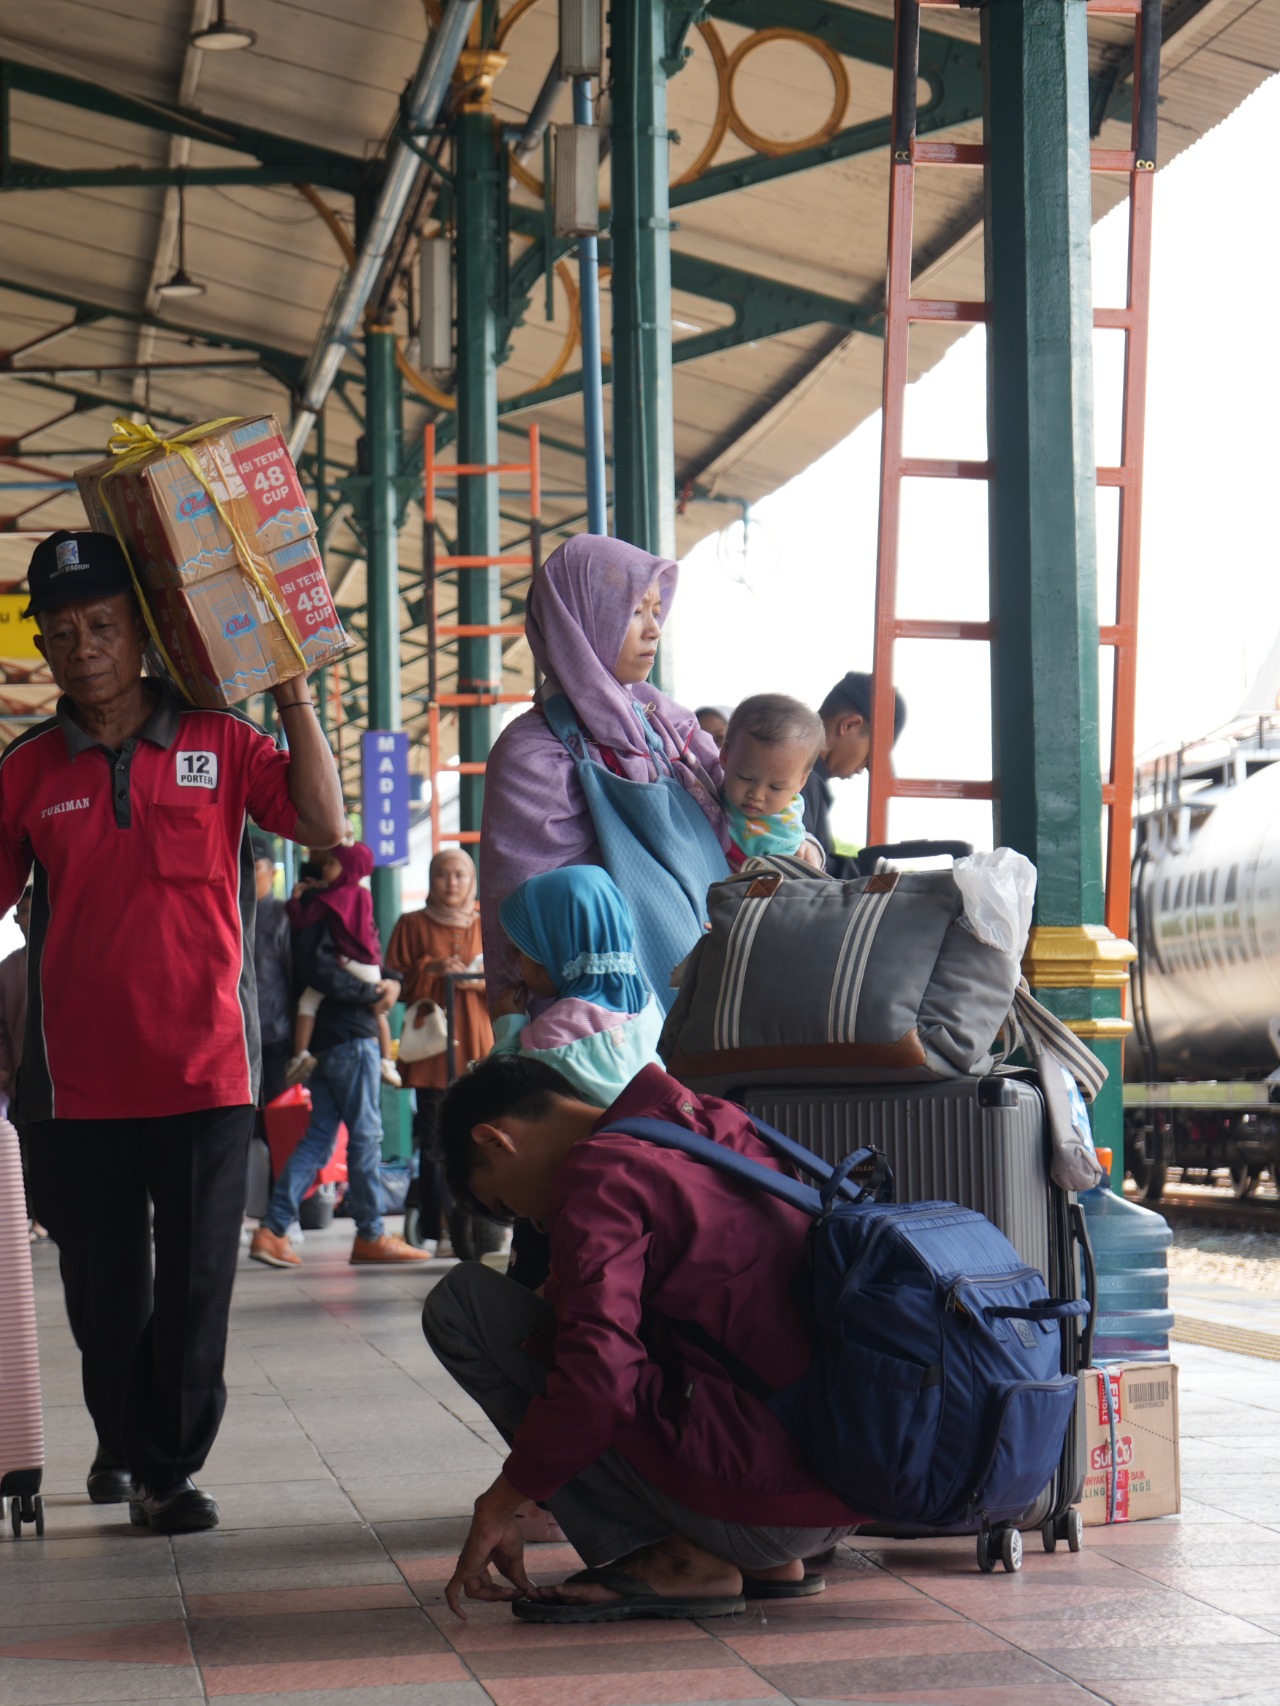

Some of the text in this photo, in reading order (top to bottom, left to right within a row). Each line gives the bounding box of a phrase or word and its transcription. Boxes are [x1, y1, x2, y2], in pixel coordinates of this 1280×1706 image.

[239, 447, 285, 475] ISI TETAP
[254, 465, 285, 491] 48
[262, 485, 290, 505] CUP
[280, 571, 324, 596] ISI TETA
[296, 586, 328, 612] 48
[225, 613, 251, 636] Club
[305, 606, 333, 626] CUP
[183, 754, 210, 775] 12
[180, 774, 214, 786] PORTER
[376, 735, 396, 857] MADIUN
[40, 797, 90, 819] TUKIMAN
[1130, 1470, 1146, 1481] BAIK
